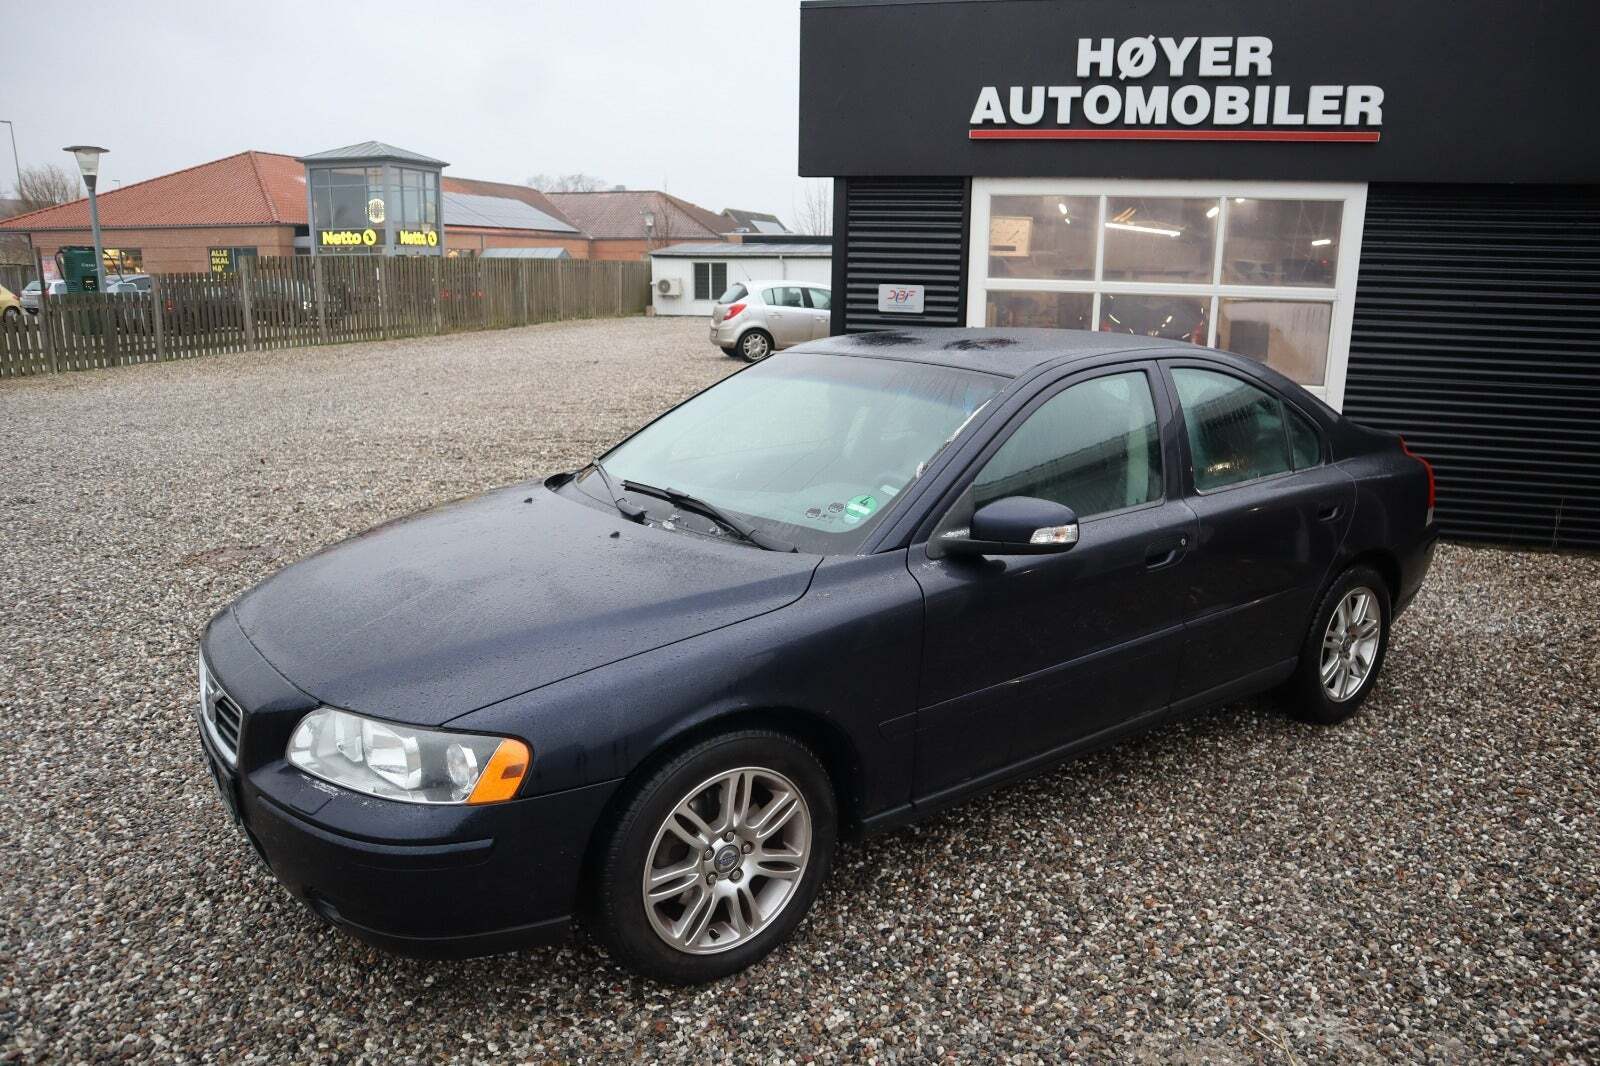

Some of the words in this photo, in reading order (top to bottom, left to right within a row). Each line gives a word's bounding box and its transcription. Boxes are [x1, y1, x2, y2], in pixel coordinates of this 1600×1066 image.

[1077, 35, 1273, 80] HØYER
[969, 84, 1385, 126] AUTOMOBILER
[322, 231, 362, 245] Netto
[400, 230, 427, 246] Netto
